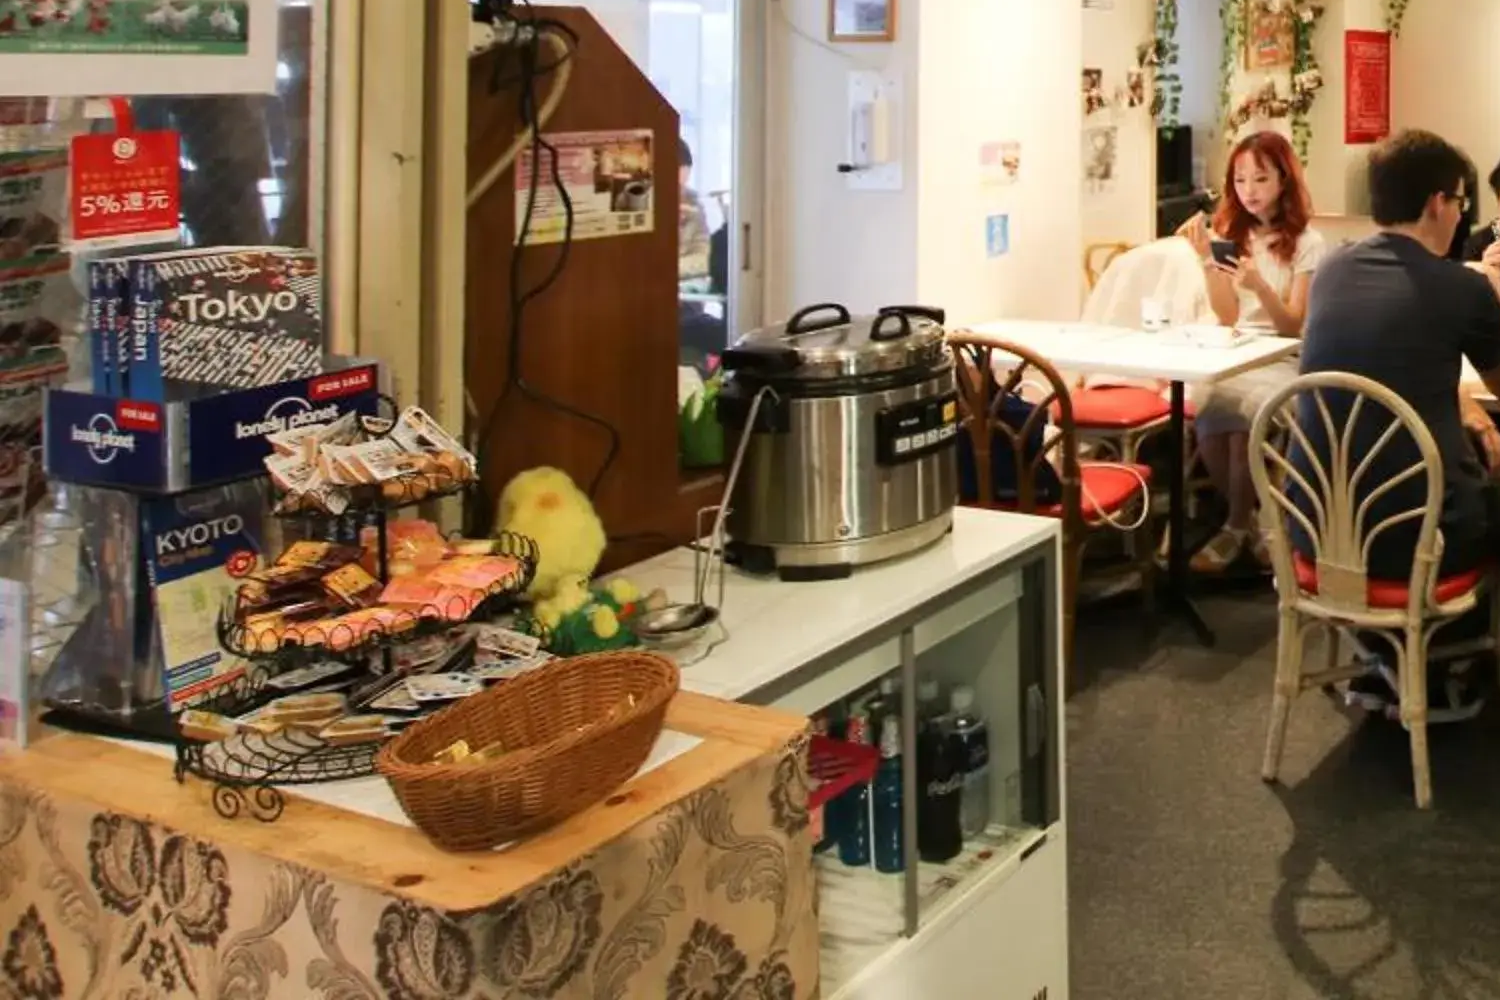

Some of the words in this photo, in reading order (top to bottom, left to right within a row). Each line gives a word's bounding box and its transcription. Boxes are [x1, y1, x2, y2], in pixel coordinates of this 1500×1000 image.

[80, 190, 170, 217] 5%還元
[178, 290, 298, 323] Tokyo
[131, 294, 148, 361] Japan
[236, 414, 287, 439] lonely
[289, 403, 339, 429] planet
[156, 514, 244, 554] KYOTO
